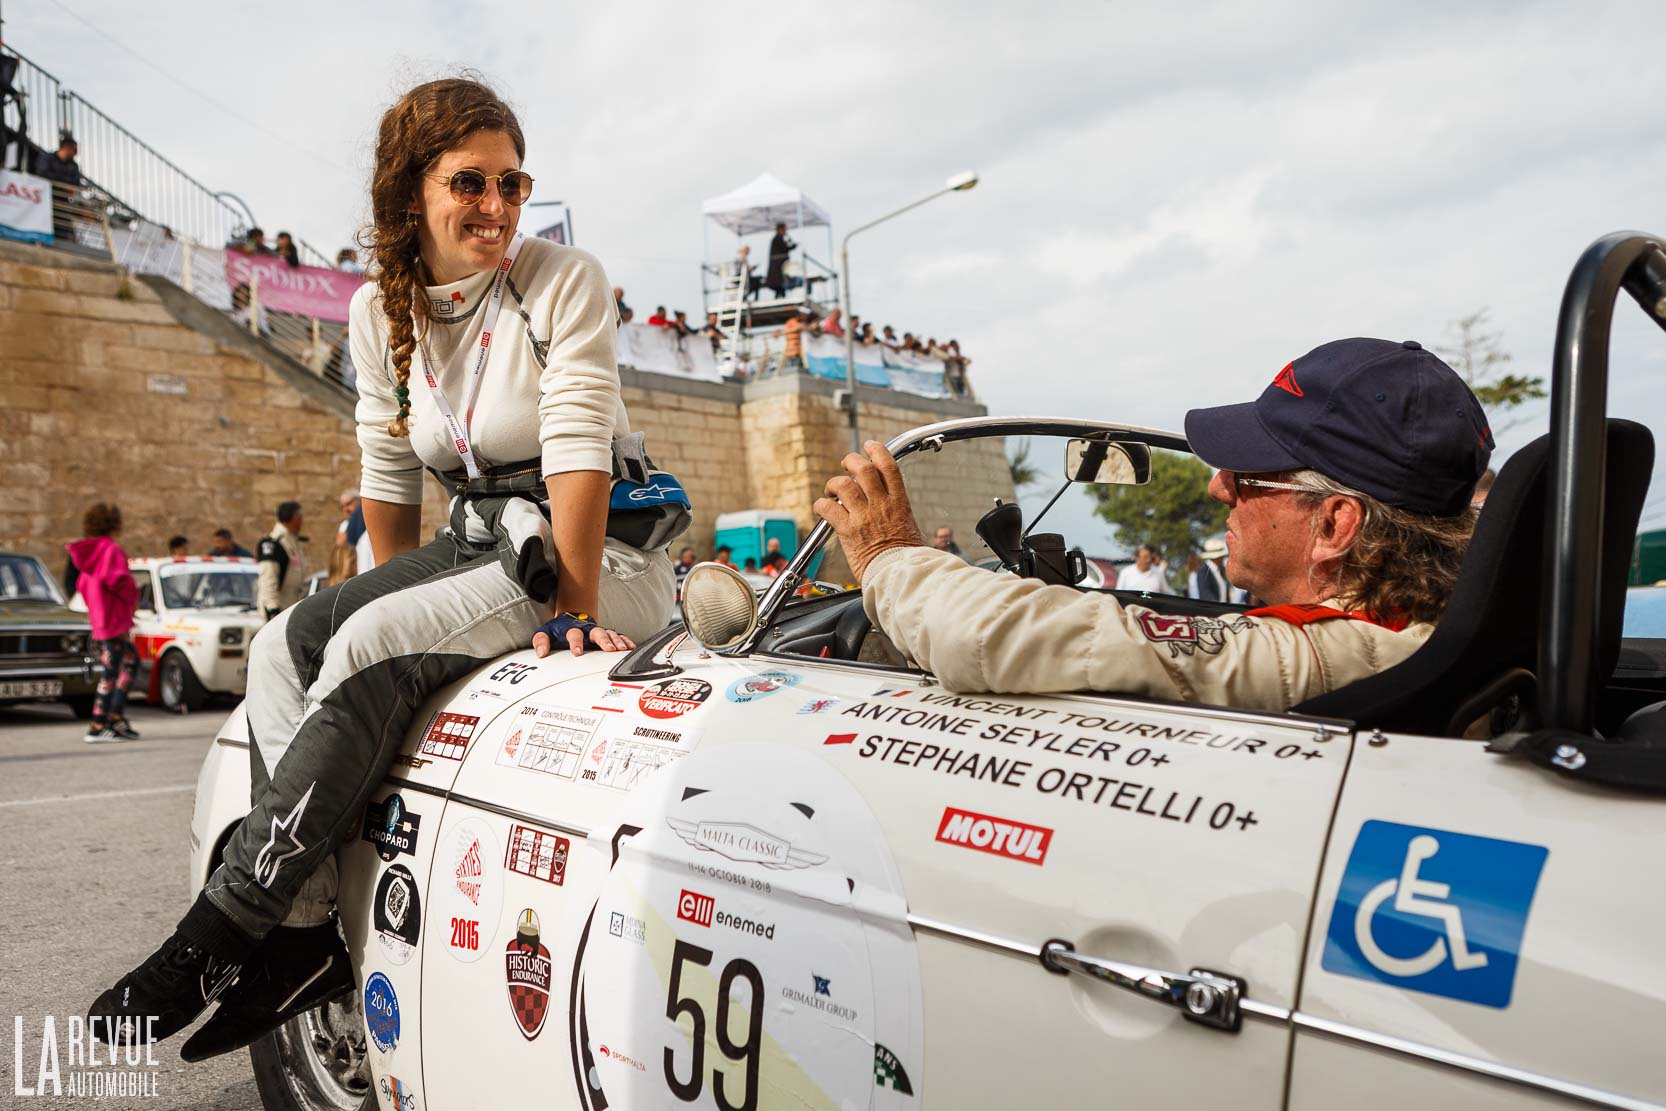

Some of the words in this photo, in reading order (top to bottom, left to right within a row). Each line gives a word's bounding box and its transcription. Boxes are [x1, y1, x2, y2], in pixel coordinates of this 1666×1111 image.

[521, 706, 539, 716] 2014
[644, 698, 695, 714] VERIFICATO
[633, 726, 681, 742] SCRUTINEERING
[841, 702, 980, 735] ANTOINE
[980, 723, 1121, 761] SEYLER
[920, 693, 1058, 719] VINCENT
[1059, 713, 1267, 754] TOURNEUR
[582, 769, 597, 780] 2015
[859, 735, 1033, 787] STEPHANE
[1036, 768, 1203, 823] ORTELLI
[370, 829, 409, 849] CHOPARD
[703, 829, 734, 846] MALTA
[738, 836, 783, 859] CLASSIC
[941, 813, 1045, 860] MOTUL
[708, 869, 747, 886] OCTOBER
[750, 878, 772, 893] 2018
[450, 917, 479, 951] 2015
[716, 910, 776, 941] enemed
[509, 956, 549, 978] HISTORIC
[512, 970, 545, 987] ENDURANCE
[371, 991, 392, 1017] 2016
[782, 987, 825, 1010] GRIMALDI
[826, 1003, 857, 1021] GROUP
[664, 939, 765, 1111] 59
[612, 1050, 646, 1072] SPORTMALTA
